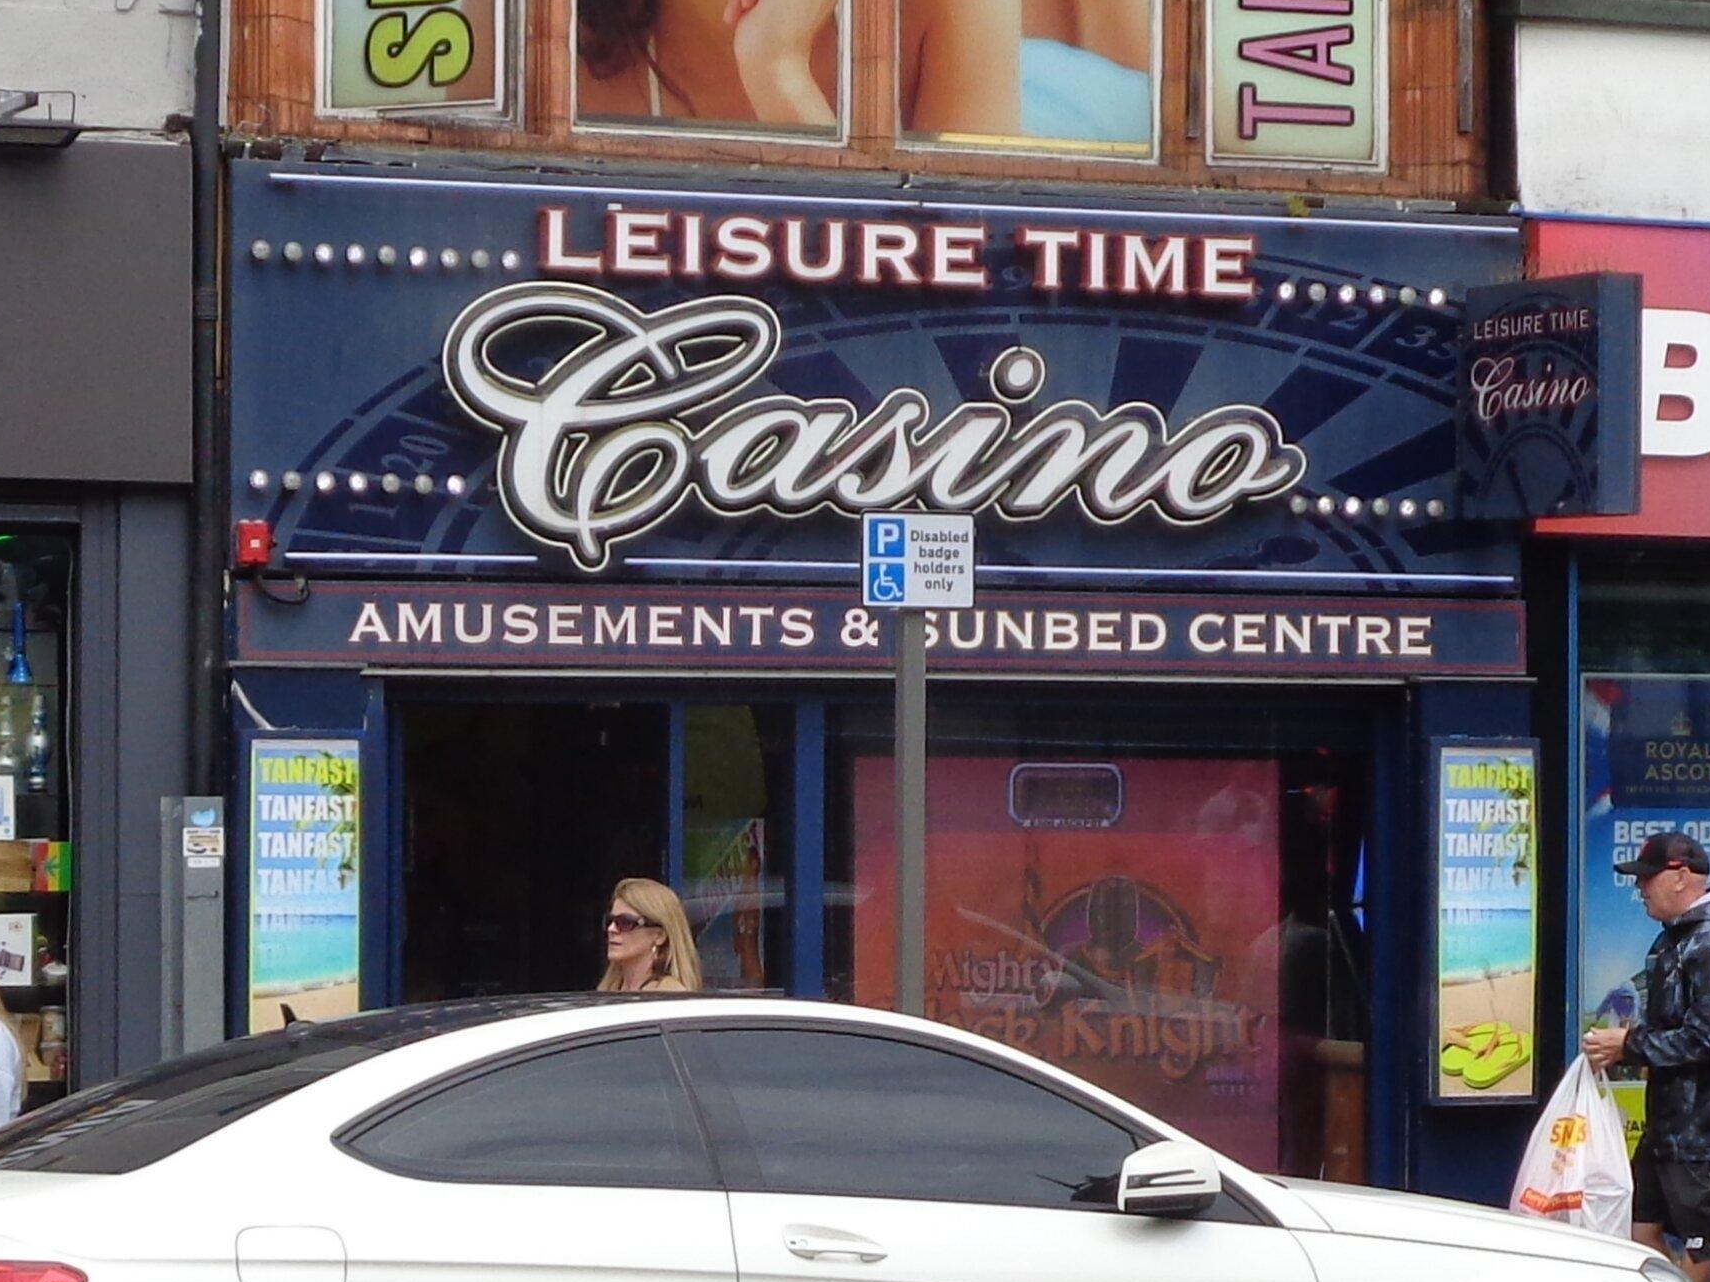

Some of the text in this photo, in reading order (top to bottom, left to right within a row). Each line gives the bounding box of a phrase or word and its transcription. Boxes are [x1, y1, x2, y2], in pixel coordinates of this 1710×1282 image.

[543, 205, 1257, 299] LEISURE TIME
[1473, 308, 1589, 340] LEISURE TIME
[1471, 356, 1589, 426] Casino
[442, 280, 1308, 572] Casino
[877, 522, 900, 555] P
[910, 529, 969, 544] Disabled
[919, 545, 960, 561] badge
[913, 562, 965, 575] holders
[925, 578, 954, 593] only
[348, 598, 1436, 659] AMUSEMENTS & SUNBED CENTRE
[258, 757, 356, 785] TANFAST
[1446, 764, 1529, 789] TANFAST
[257, 794, 355, 822] TANFAST
[1445, 798, 1530, 823] TANFAST
[257, 831, 355, 858] TANFAST
[1444, 833, 1530, 857] TANFAST
[1614, 820, 1677, 844] BEST
[925, 948, 1064, 1009] Mighty
[1061, 999, 1267, 1081] Knight
